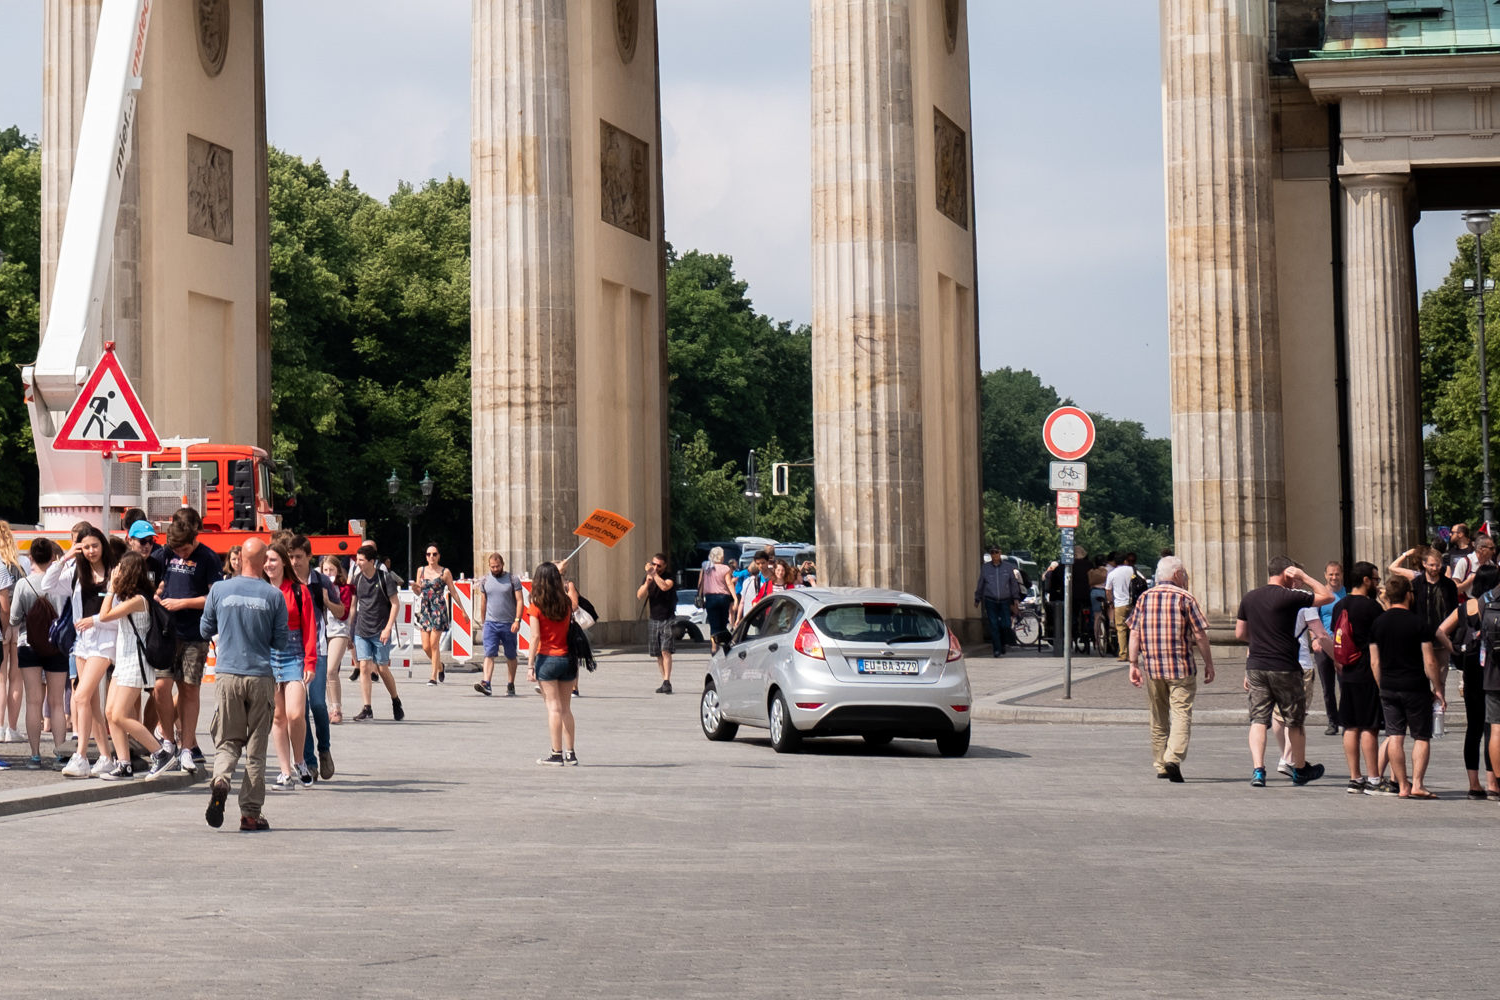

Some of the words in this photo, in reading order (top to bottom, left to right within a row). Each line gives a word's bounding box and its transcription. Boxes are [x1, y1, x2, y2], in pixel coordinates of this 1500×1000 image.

[582, 522, 601, 532] Starts
[601, 529, 618, 540] now
[590, 514, 607, 523] FREE
[607, 518, 629, 533] TOUR
[864, 661, 876, 669] EU
[882, 661, 894, 670] BA
[895, 661, 917, 671] 3279
